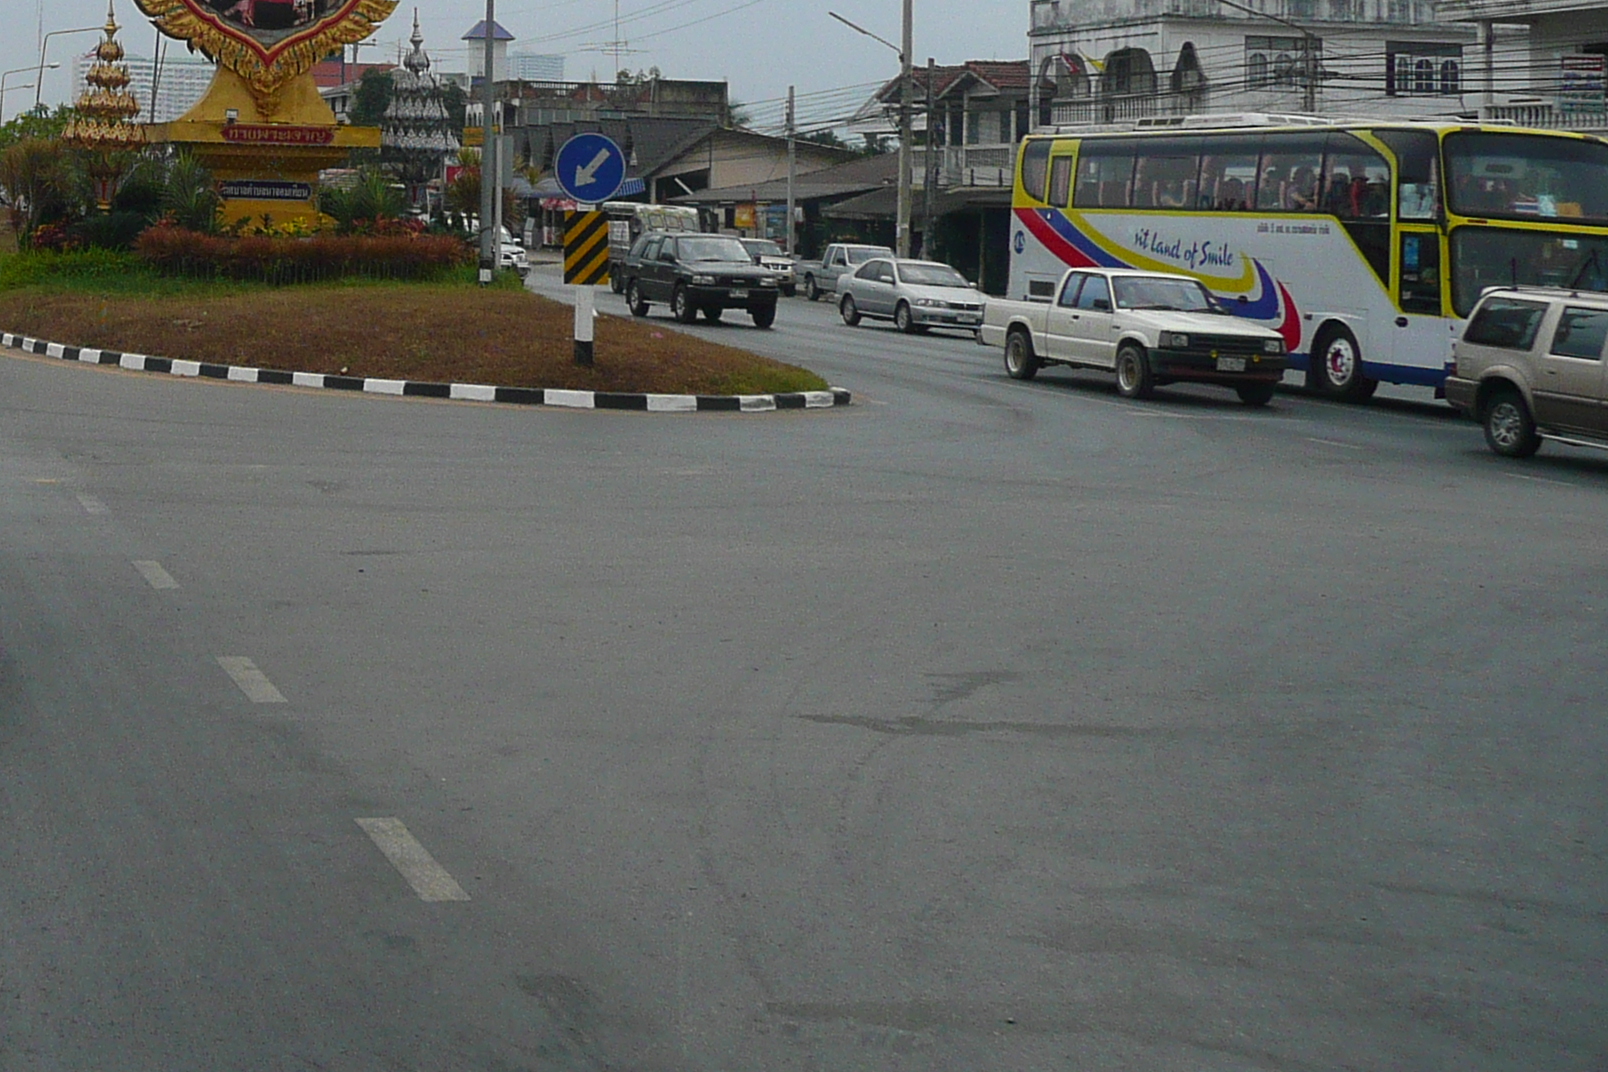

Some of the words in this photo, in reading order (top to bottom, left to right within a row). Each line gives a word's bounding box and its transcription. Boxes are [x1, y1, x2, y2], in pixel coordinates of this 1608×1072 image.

[1150, 231, 1181, 260] Land
[1184, 241, 1198, 270] of
[1199, 240, 1234, 267] Smile
